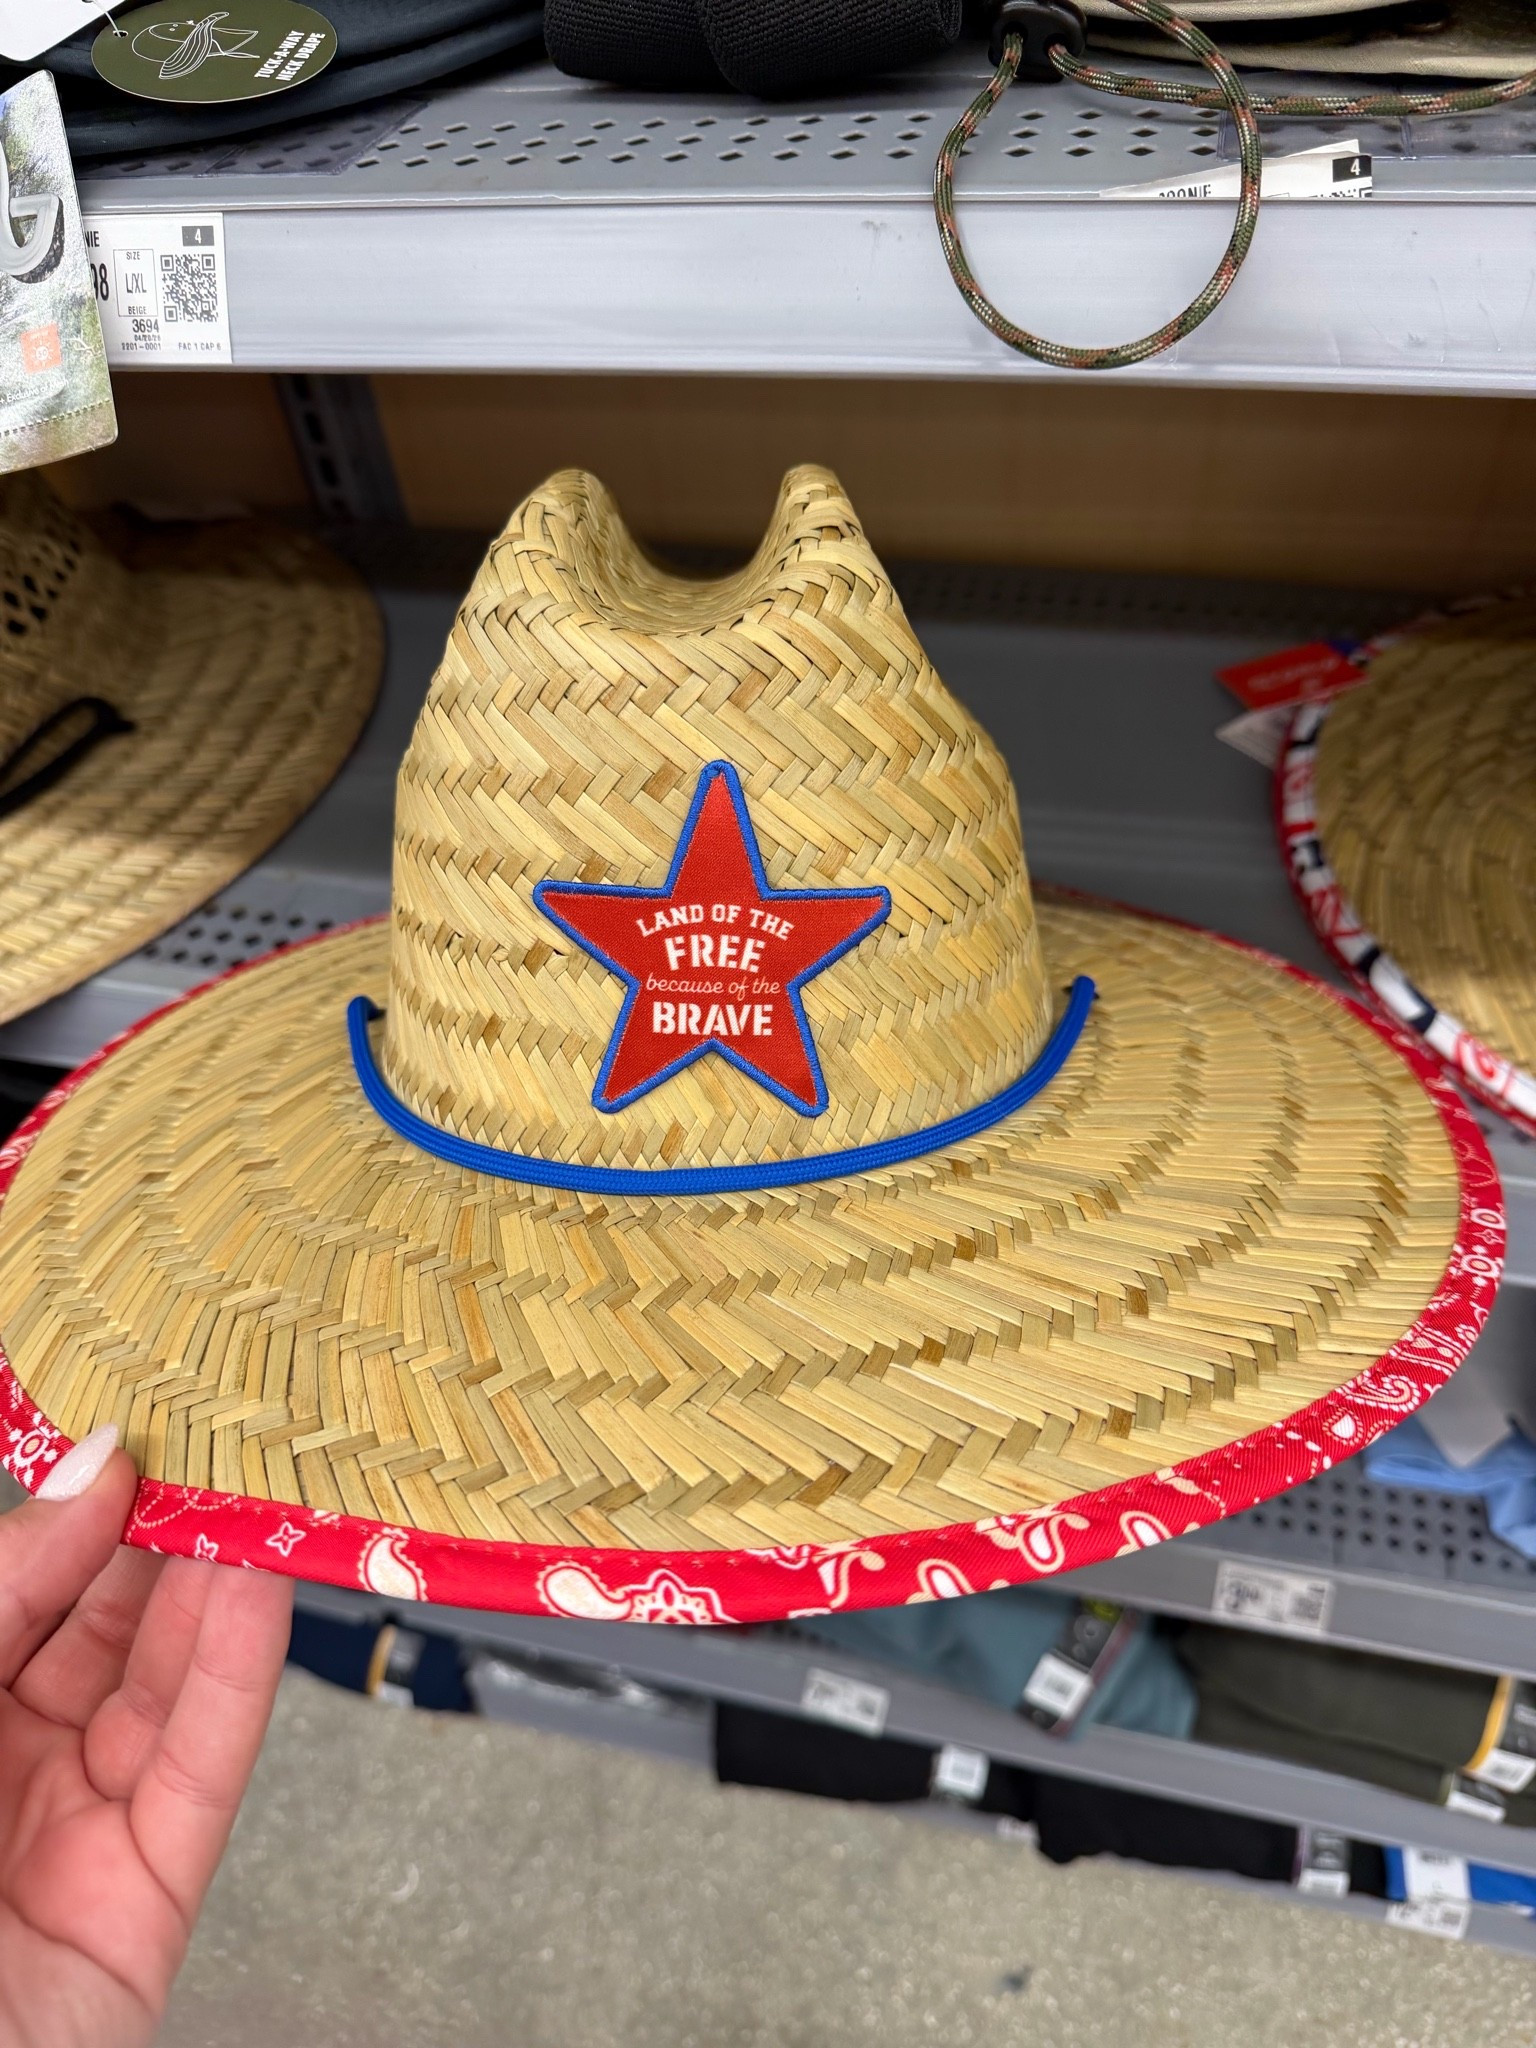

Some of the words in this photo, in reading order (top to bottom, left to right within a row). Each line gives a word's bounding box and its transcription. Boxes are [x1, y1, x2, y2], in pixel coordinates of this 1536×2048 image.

[254, 30, 305, 78] TUCK-A-WAY
[275, 59, 305, 81] NECK
[293, 32, 326, 59] DRAPE
[1350, 158, 1361, 176] 4
[194, 228, 202, 245] 4
[126, 251, 141, 260] SIZE
[125, 272, 147, 294] L/XL
[128, 305, 147, 315] BEIGE
[132, 318, 160, 334] 3694
[200, 342, 215, 351] CAP
[636, 904, 705, 938] LAND
[711, 903, 742, 923] OF
[749, 908, 795, 941] THE
[664, 934, 766, 973] FREE
[646, 972, 724, 994] because
[728, 976, 749, 1001] of
[752, 977, 781, 994] the
[652, 1001, 774, 1037] BRAVE
